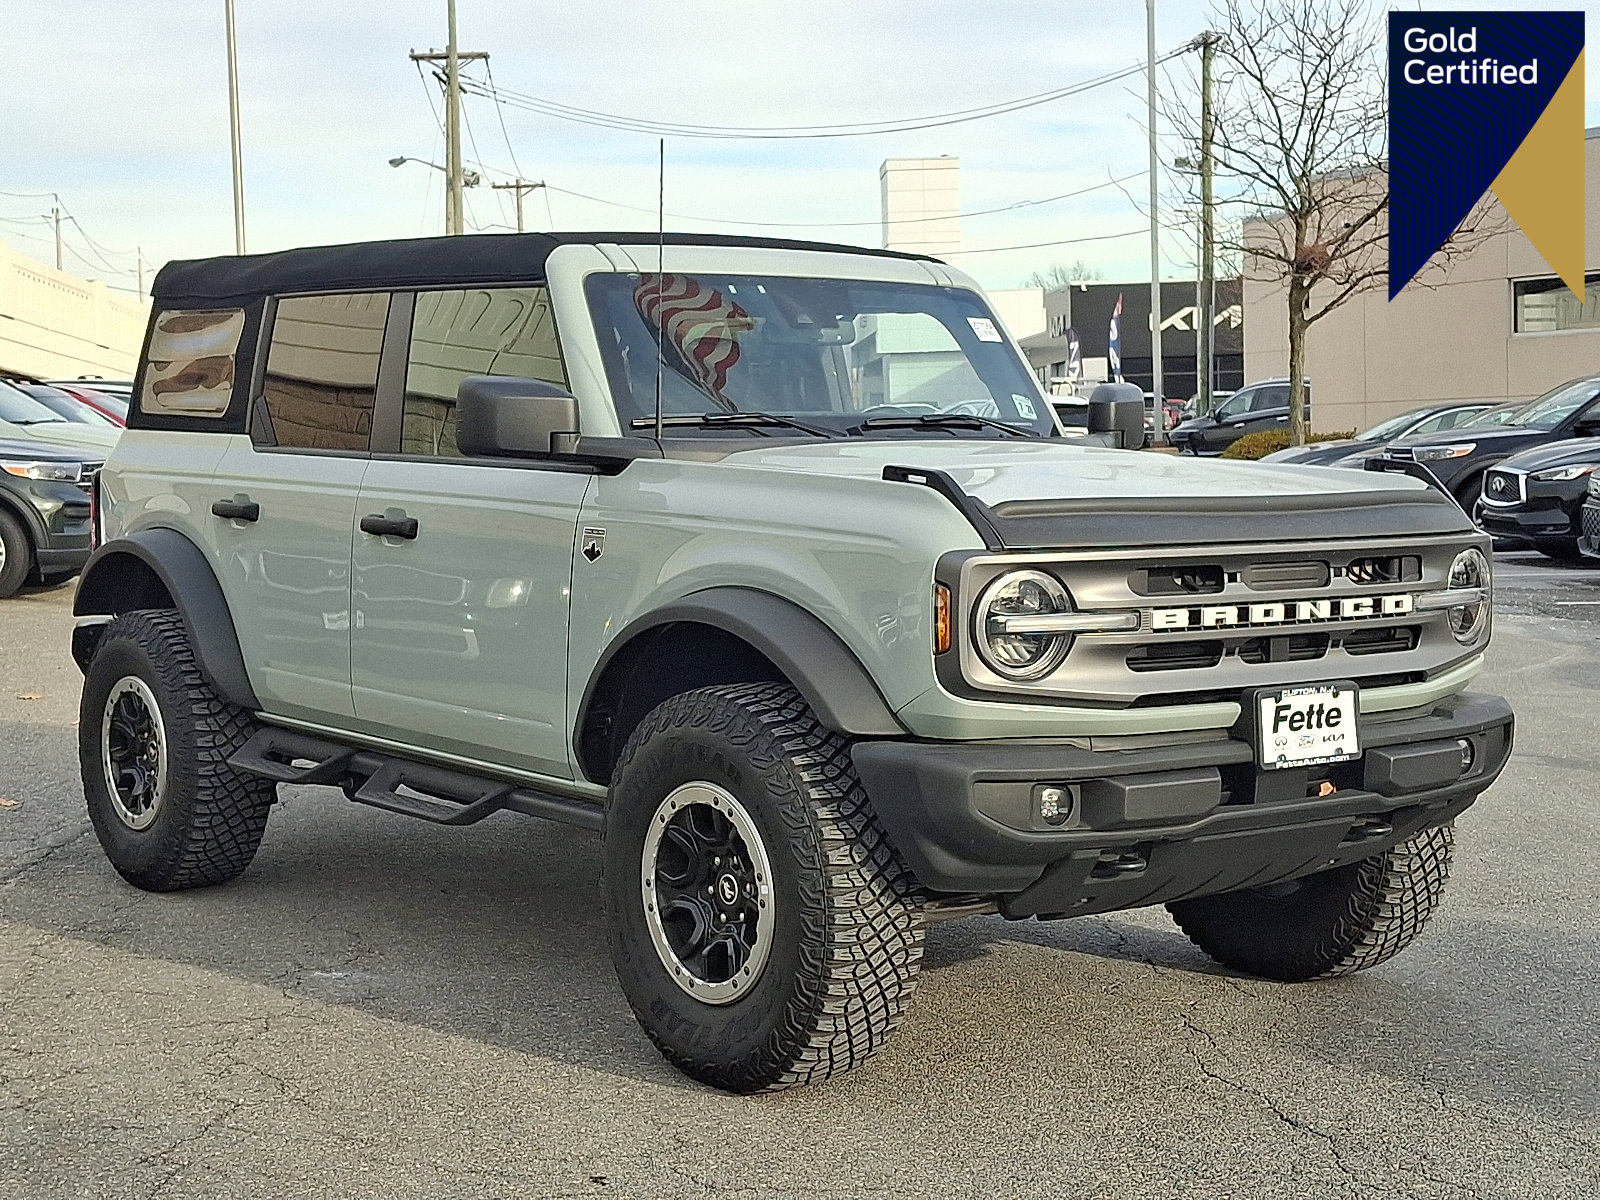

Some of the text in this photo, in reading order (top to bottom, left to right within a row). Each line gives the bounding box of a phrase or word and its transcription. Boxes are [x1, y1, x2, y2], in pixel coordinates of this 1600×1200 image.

[1152, 595, 1412, 629] BRONCO
[1273, 703, 1342, 734] Fette
[1322, 733, 1345, 743] KIA
